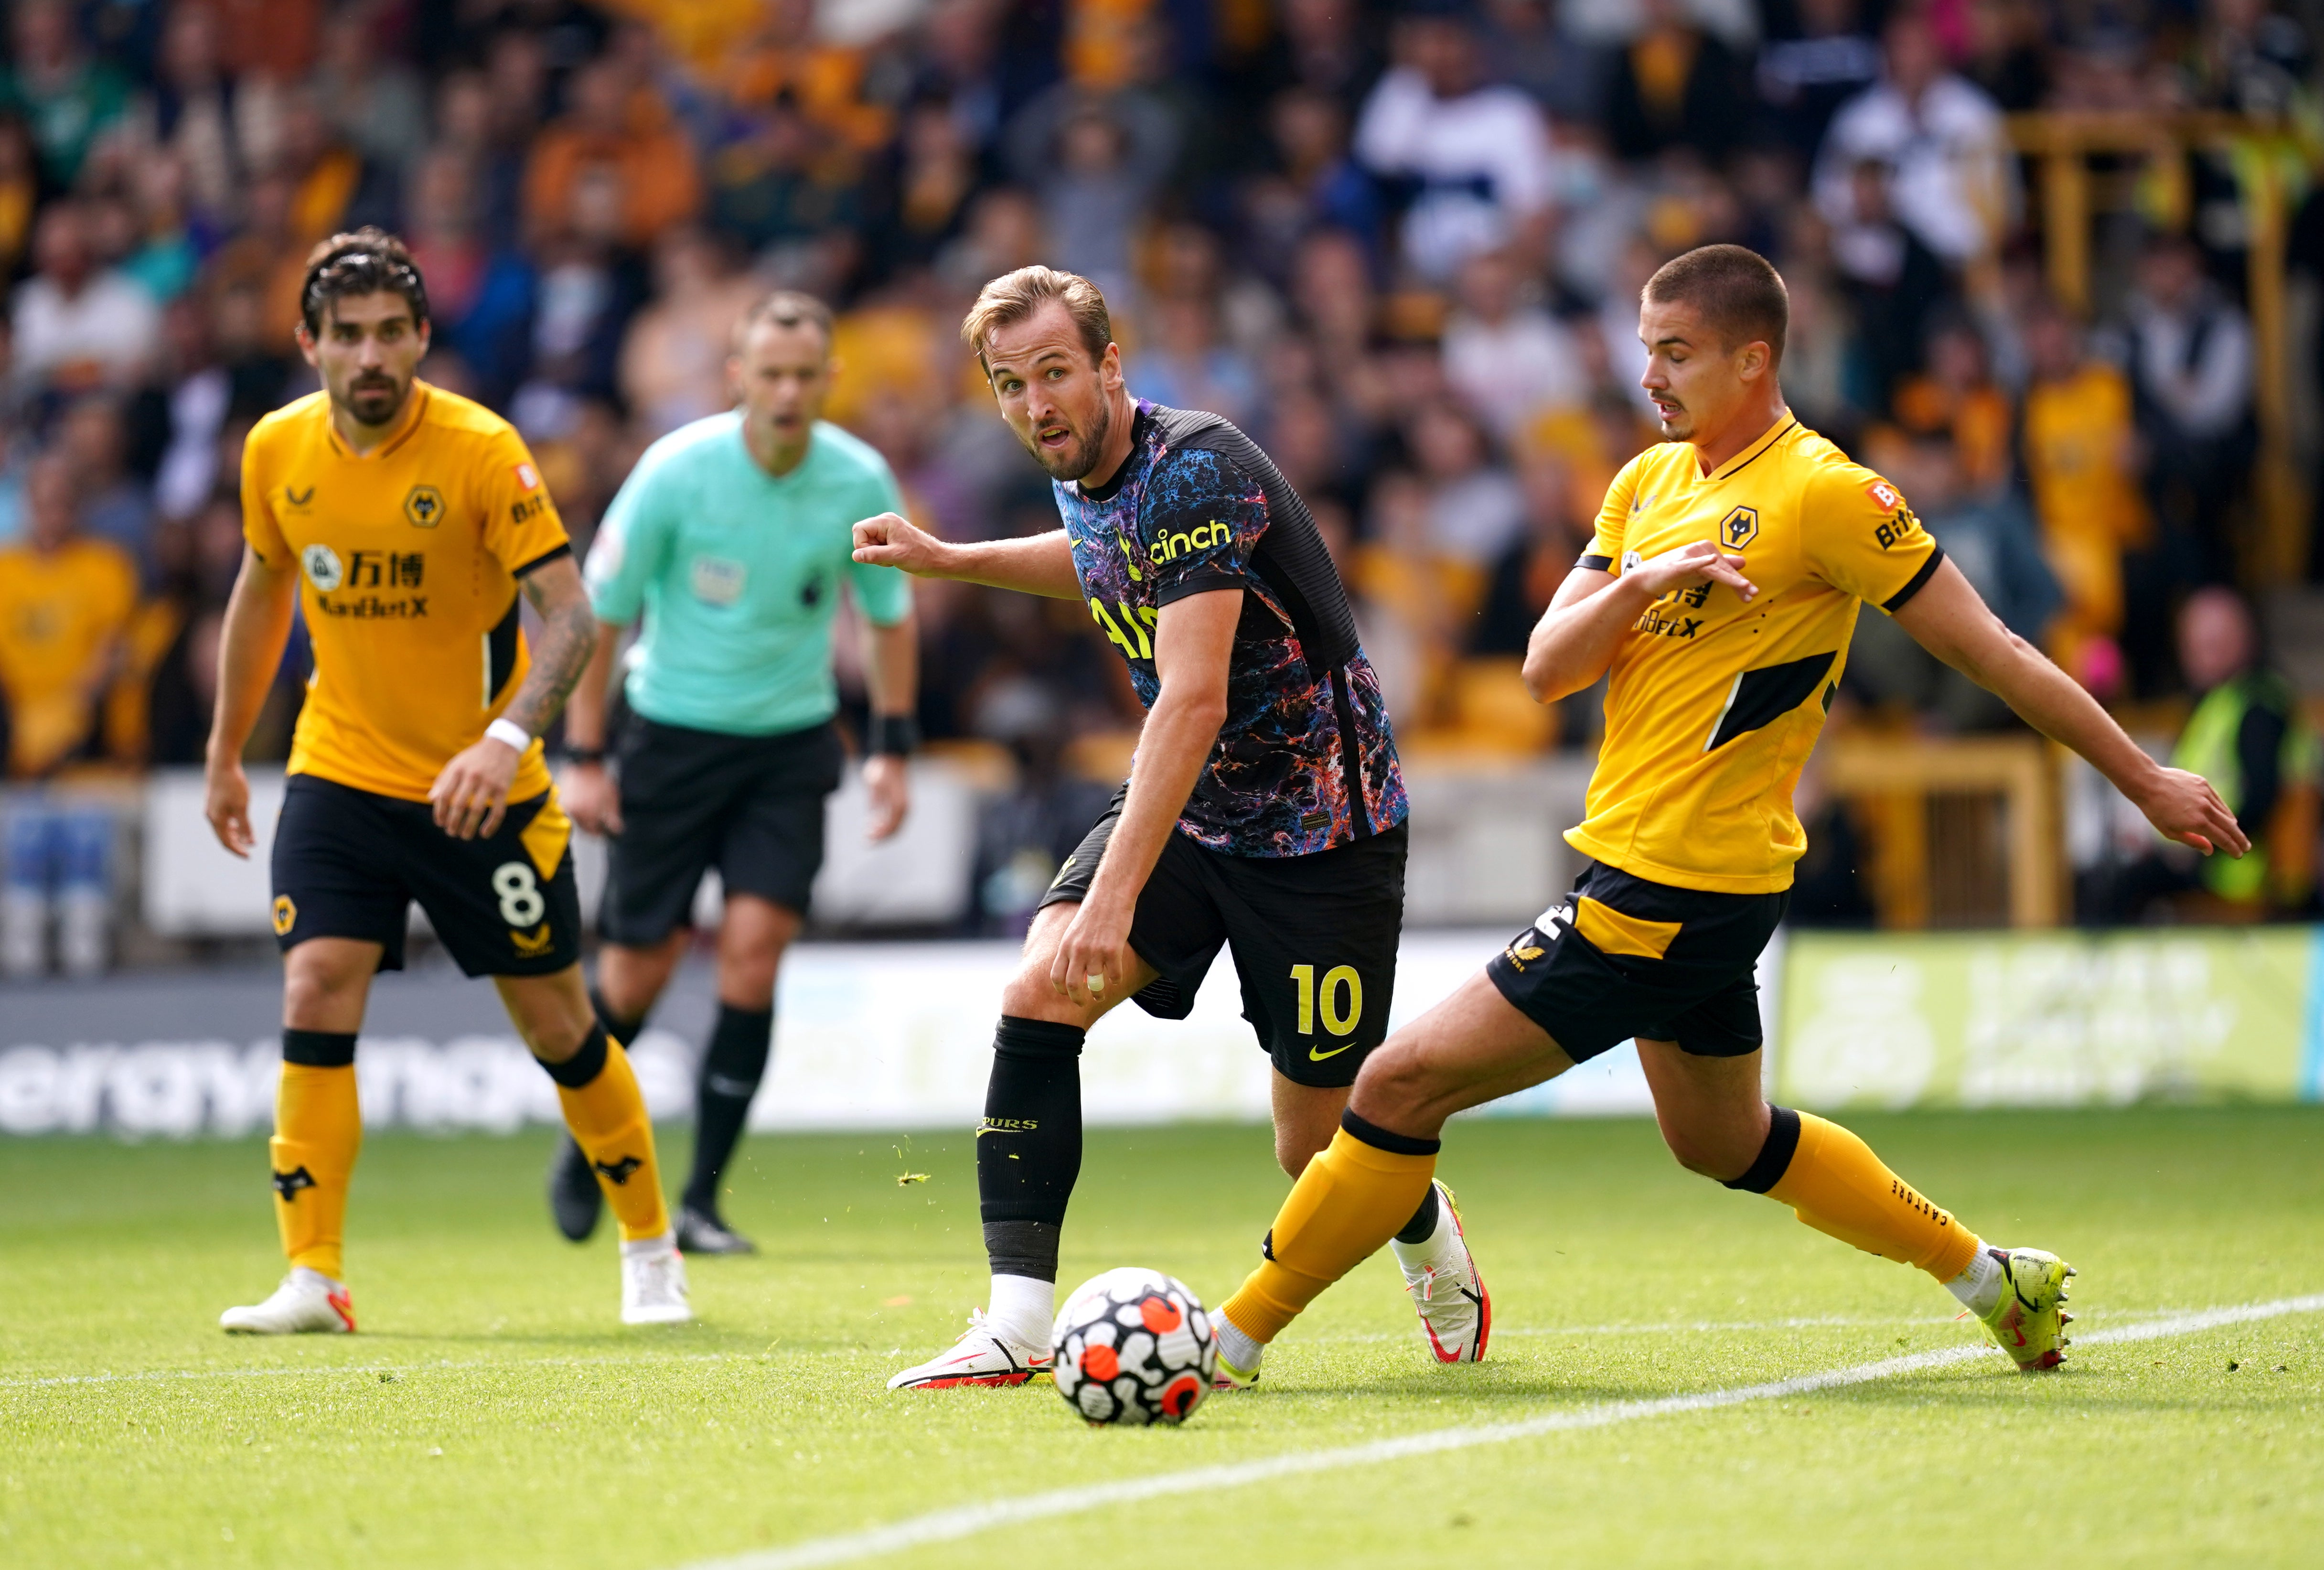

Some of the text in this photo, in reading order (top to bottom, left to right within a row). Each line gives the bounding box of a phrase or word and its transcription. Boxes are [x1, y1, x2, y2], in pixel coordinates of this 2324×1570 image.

[1150, 520, 1232, 565] cinch
[1632, 608, 1706, 639] nBetX
[492, 861, 545, 927] 8
[1289, 964, 1362, 1036] 10
[982, 1117, 1039, 1129] PURS
[1892, 1180, 1948, 1226] CASTORE
